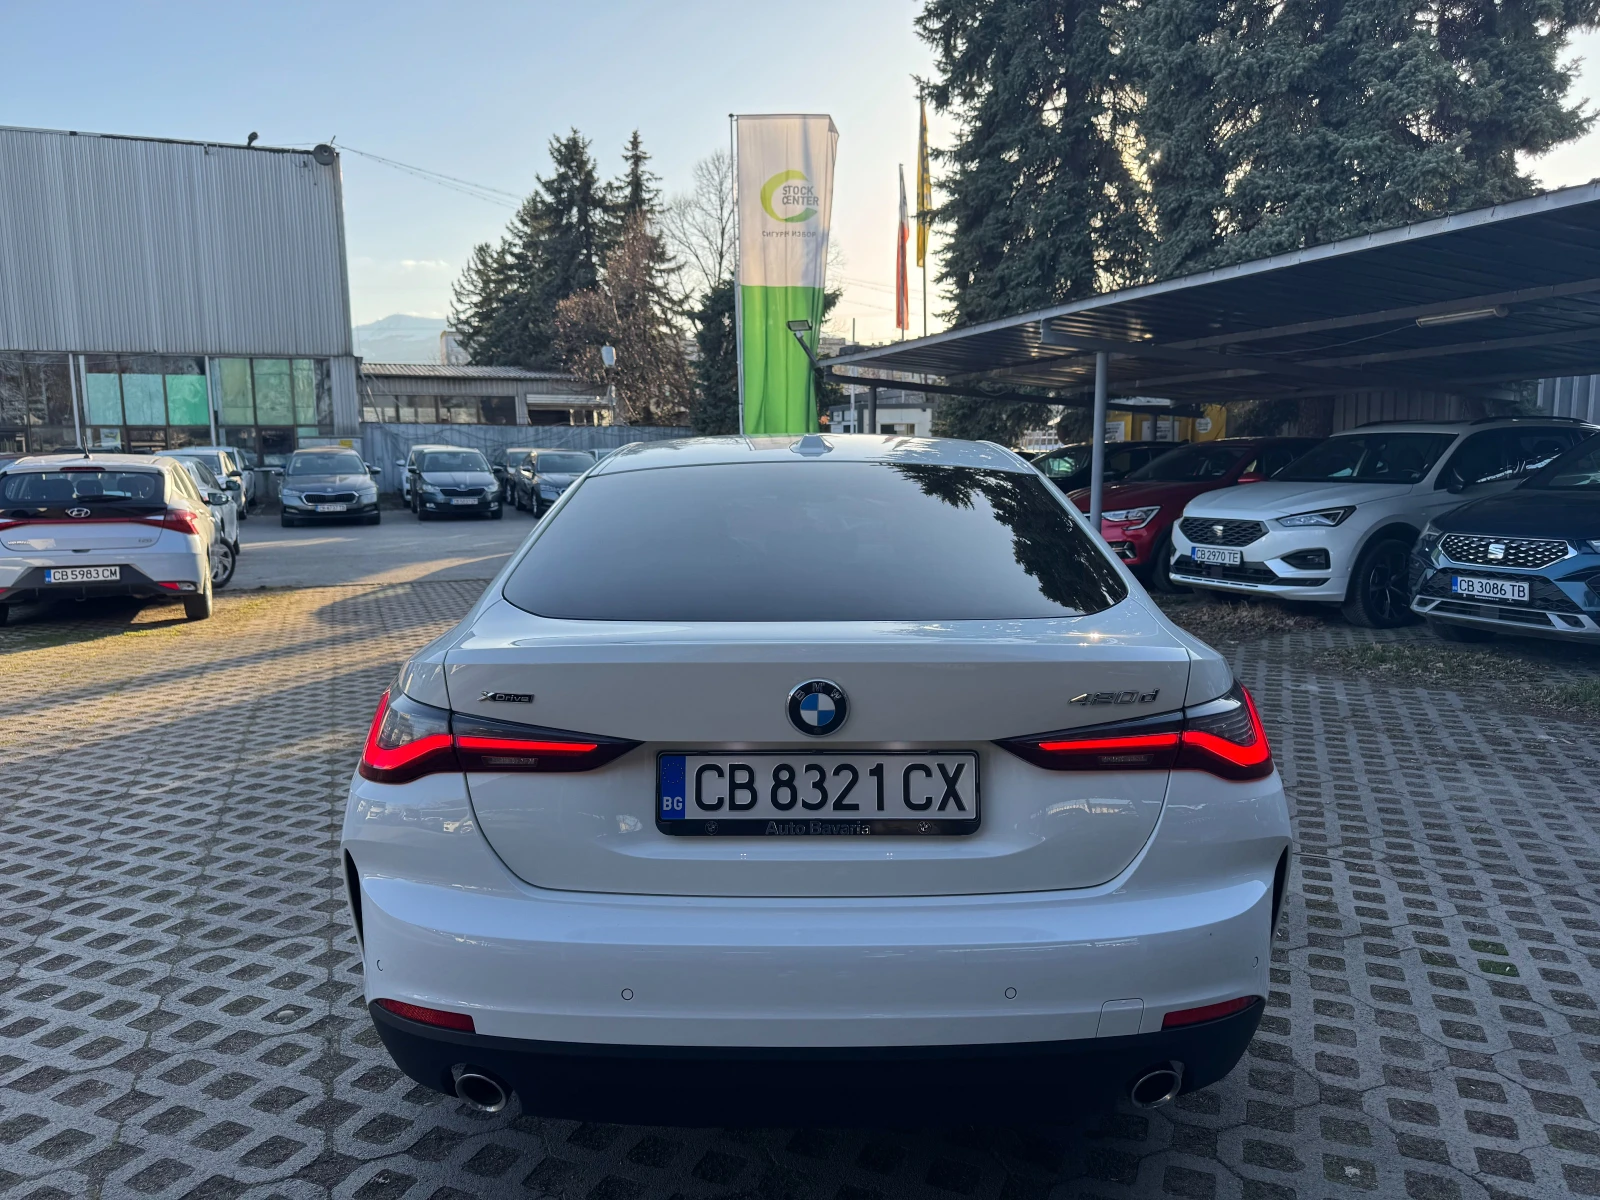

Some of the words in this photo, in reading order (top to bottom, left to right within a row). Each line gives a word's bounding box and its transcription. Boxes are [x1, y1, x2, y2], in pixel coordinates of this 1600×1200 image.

[782, 185, 814, 196] STOCK
[782, 195, 820, 206] CENTER
[791, 230, 817, 238] ИЗБОР
[1196, 549, 1206, 560] CB
[1206, 550, 1226, 562] 2970
[1227, 551, 1239, 563] TE
[53, 570, 69, 581] CB
[70, 568, 100, 580] 5983
[101, 568, 118, 579] CM
[1459, 579, 1475, 592] CB
[1476, 580, 1507, 596] 3086
[1509, 583, 1526, 598] TB
[794, 682, 843, 701] BMW
[1067, 687, 1161, 706] 420d
[695, 762, 758, 812] CB
[770, 762, 885, 812] 8321
[902, 762, 968, 812] CX
[662, 796, 683, 811] BG
[765, 820, 807, 836] Auto
[809, 820, 871, 836] Bavaria
